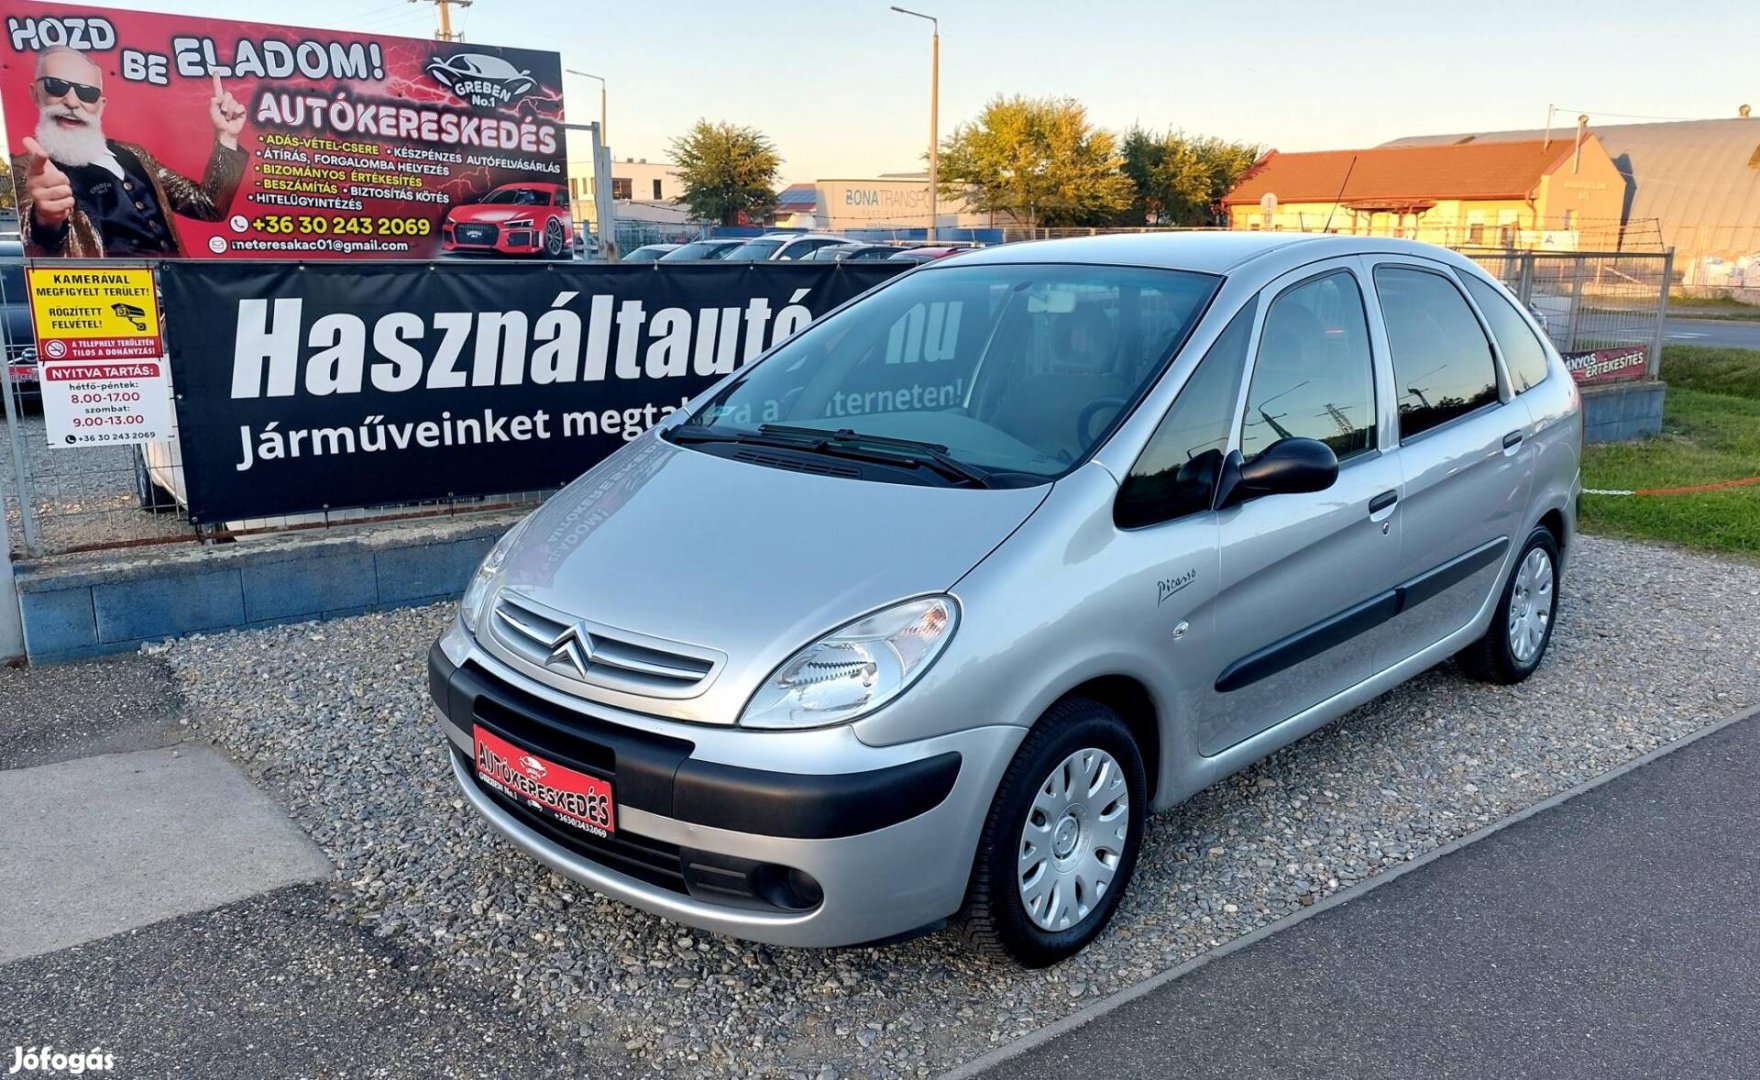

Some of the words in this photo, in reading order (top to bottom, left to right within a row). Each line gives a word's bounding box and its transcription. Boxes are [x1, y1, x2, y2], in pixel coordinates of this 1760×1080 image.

[8, 18, 116, 50] HOZD
[123, 51, 168, 85] BE
[174, 38, 384, 80] ELADOM!
[455, 81, 511, 102] GREBEN
[472, 95, 495, 107] No.1
[257, 92, 556, 154] AUTÓKERESKEDÉS
[266, 133, 379, 155] ADÁS-VÉTEL-CSERE
[394, 147, 462, 164] KÉSZPÉNZES
[467, 155, 561, 174] AUTÓFELVÁSÁRLÁS
[314, 154, 395, 171] FORGALOMBA
[398, 161, 449, 176] HELYEZÉS
[263, 164, 346, 180] BIZOMÁNYOS
[351, 170, 422, 187] ÉRTÉKESÍTÉS
[264, 178, 338, 194] BESZÁMÍTÁS
[351, 185, 413, 200] BIZTOSÍTÁS
[416, 190, 449, 204] KÖTÉS
[256, 193, 363, 211] HITELÜGYINTÉZÉS
[252, 216, 294, 233] +36
[299, 216, 328, 234] 30
[332, 217, 373, 234] 243
[377, 218, 431, 235] 2069
[232, 238, 408, 253] meteresakac01@gmail.com
[53, 272, 130, 284] KAMERÁVAL
[36, 288, 99, 297] MEGFIGYELT
[104, 285, 149, 297] TERÜLET!
[49, 305, 102, 316] RÖGZÍTETT
[52, 318, 102, 329] FELVÉTEL!
[79, 340, 116, 348] TELEPHELY
[52, 368, 102, 379] NYITVA
[104, 365, 154, 377] TARTÁS:
[71, 392, 140, 404] 8.00-17.00
[85, 405, 130, 414] szombat:
[73, 415, 144, 427] 9.00-13.00
[236, 408, 550, 470] Járműveinket
[1157, 568, 1196, 608] Picasso
[479, 740, 610, 827] AUTÓKERESKEDÉS
